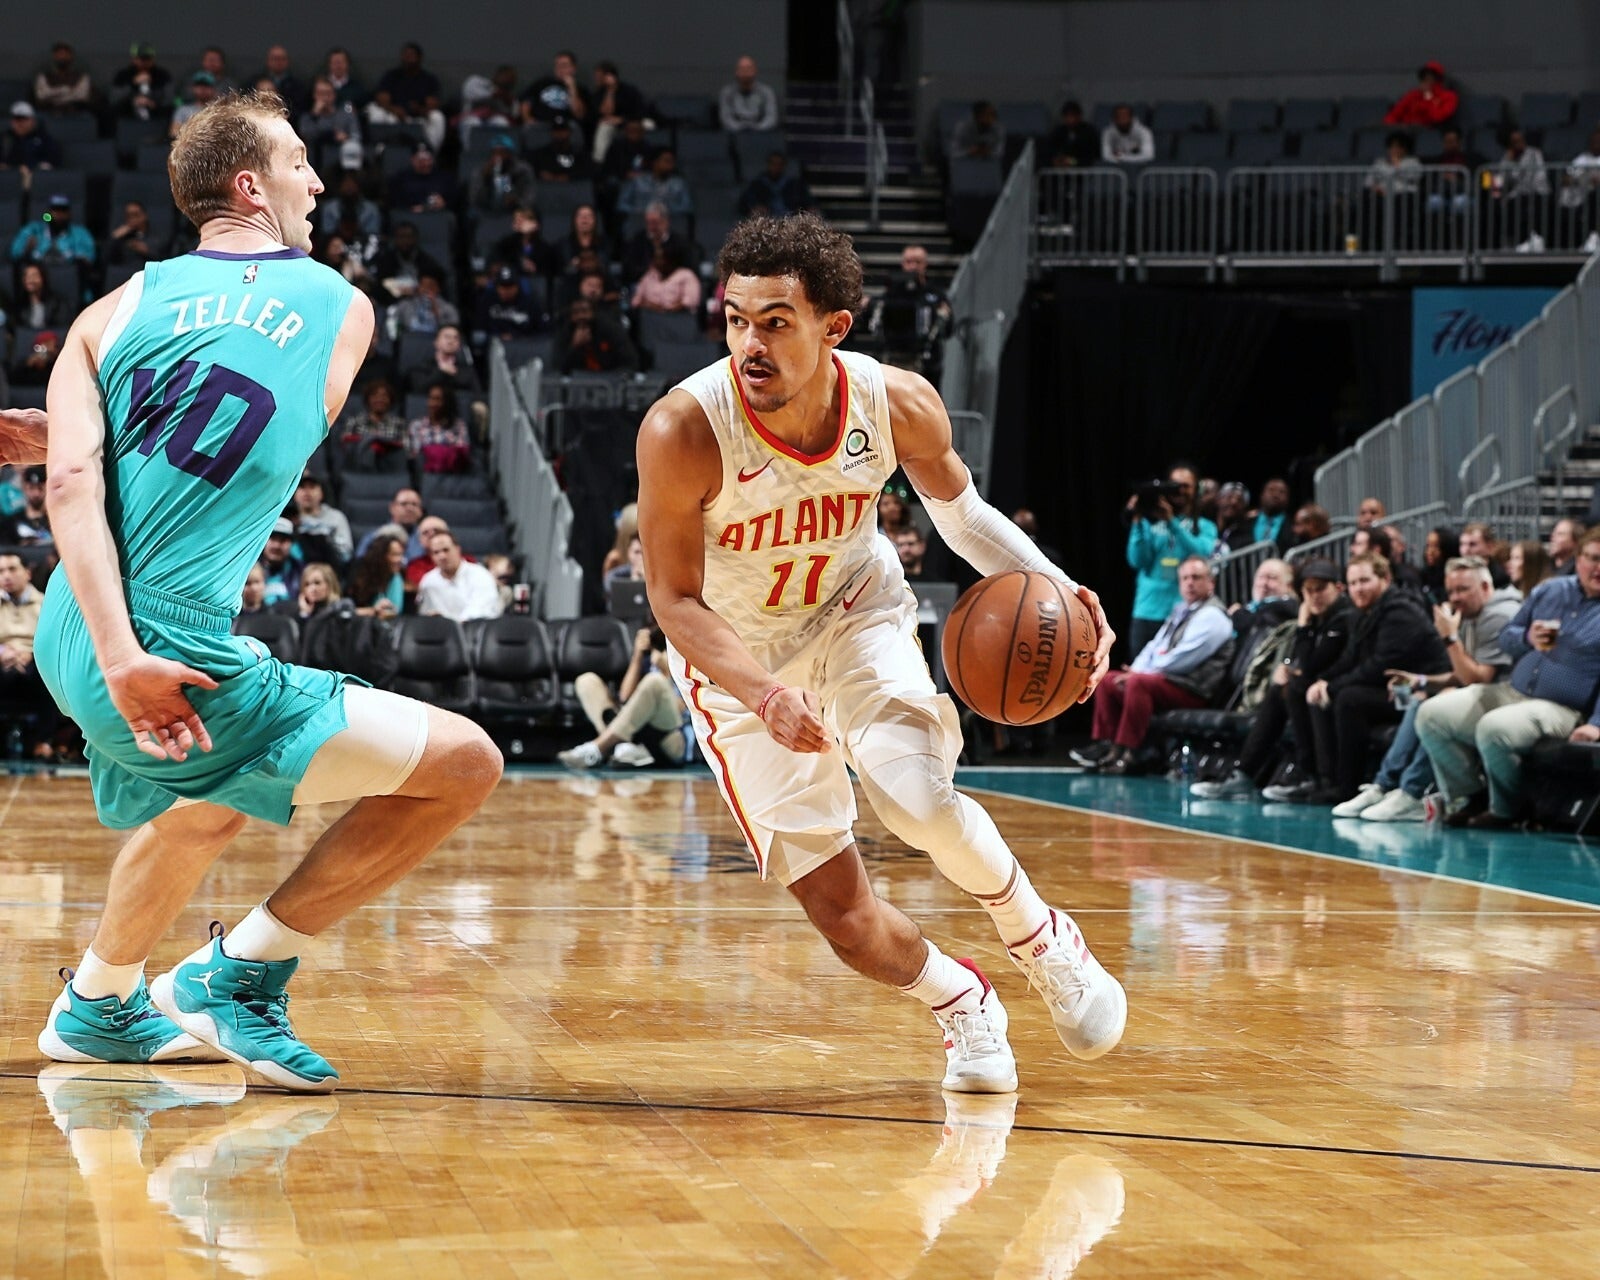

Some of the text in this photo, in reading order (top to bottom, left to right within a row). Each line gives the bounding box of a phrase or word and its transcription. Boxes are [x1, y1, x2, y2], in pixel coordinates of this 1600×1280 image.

[171, 294, 304, 349] ZELLER
[125, 360, 277, 490] 40
[842, 454, 879, 472] sharecare
[717, 490, 879, 552] ATLANT
[763, 554, 833, 609] 11
[1018, 601, 1059, 706] SPALDING
